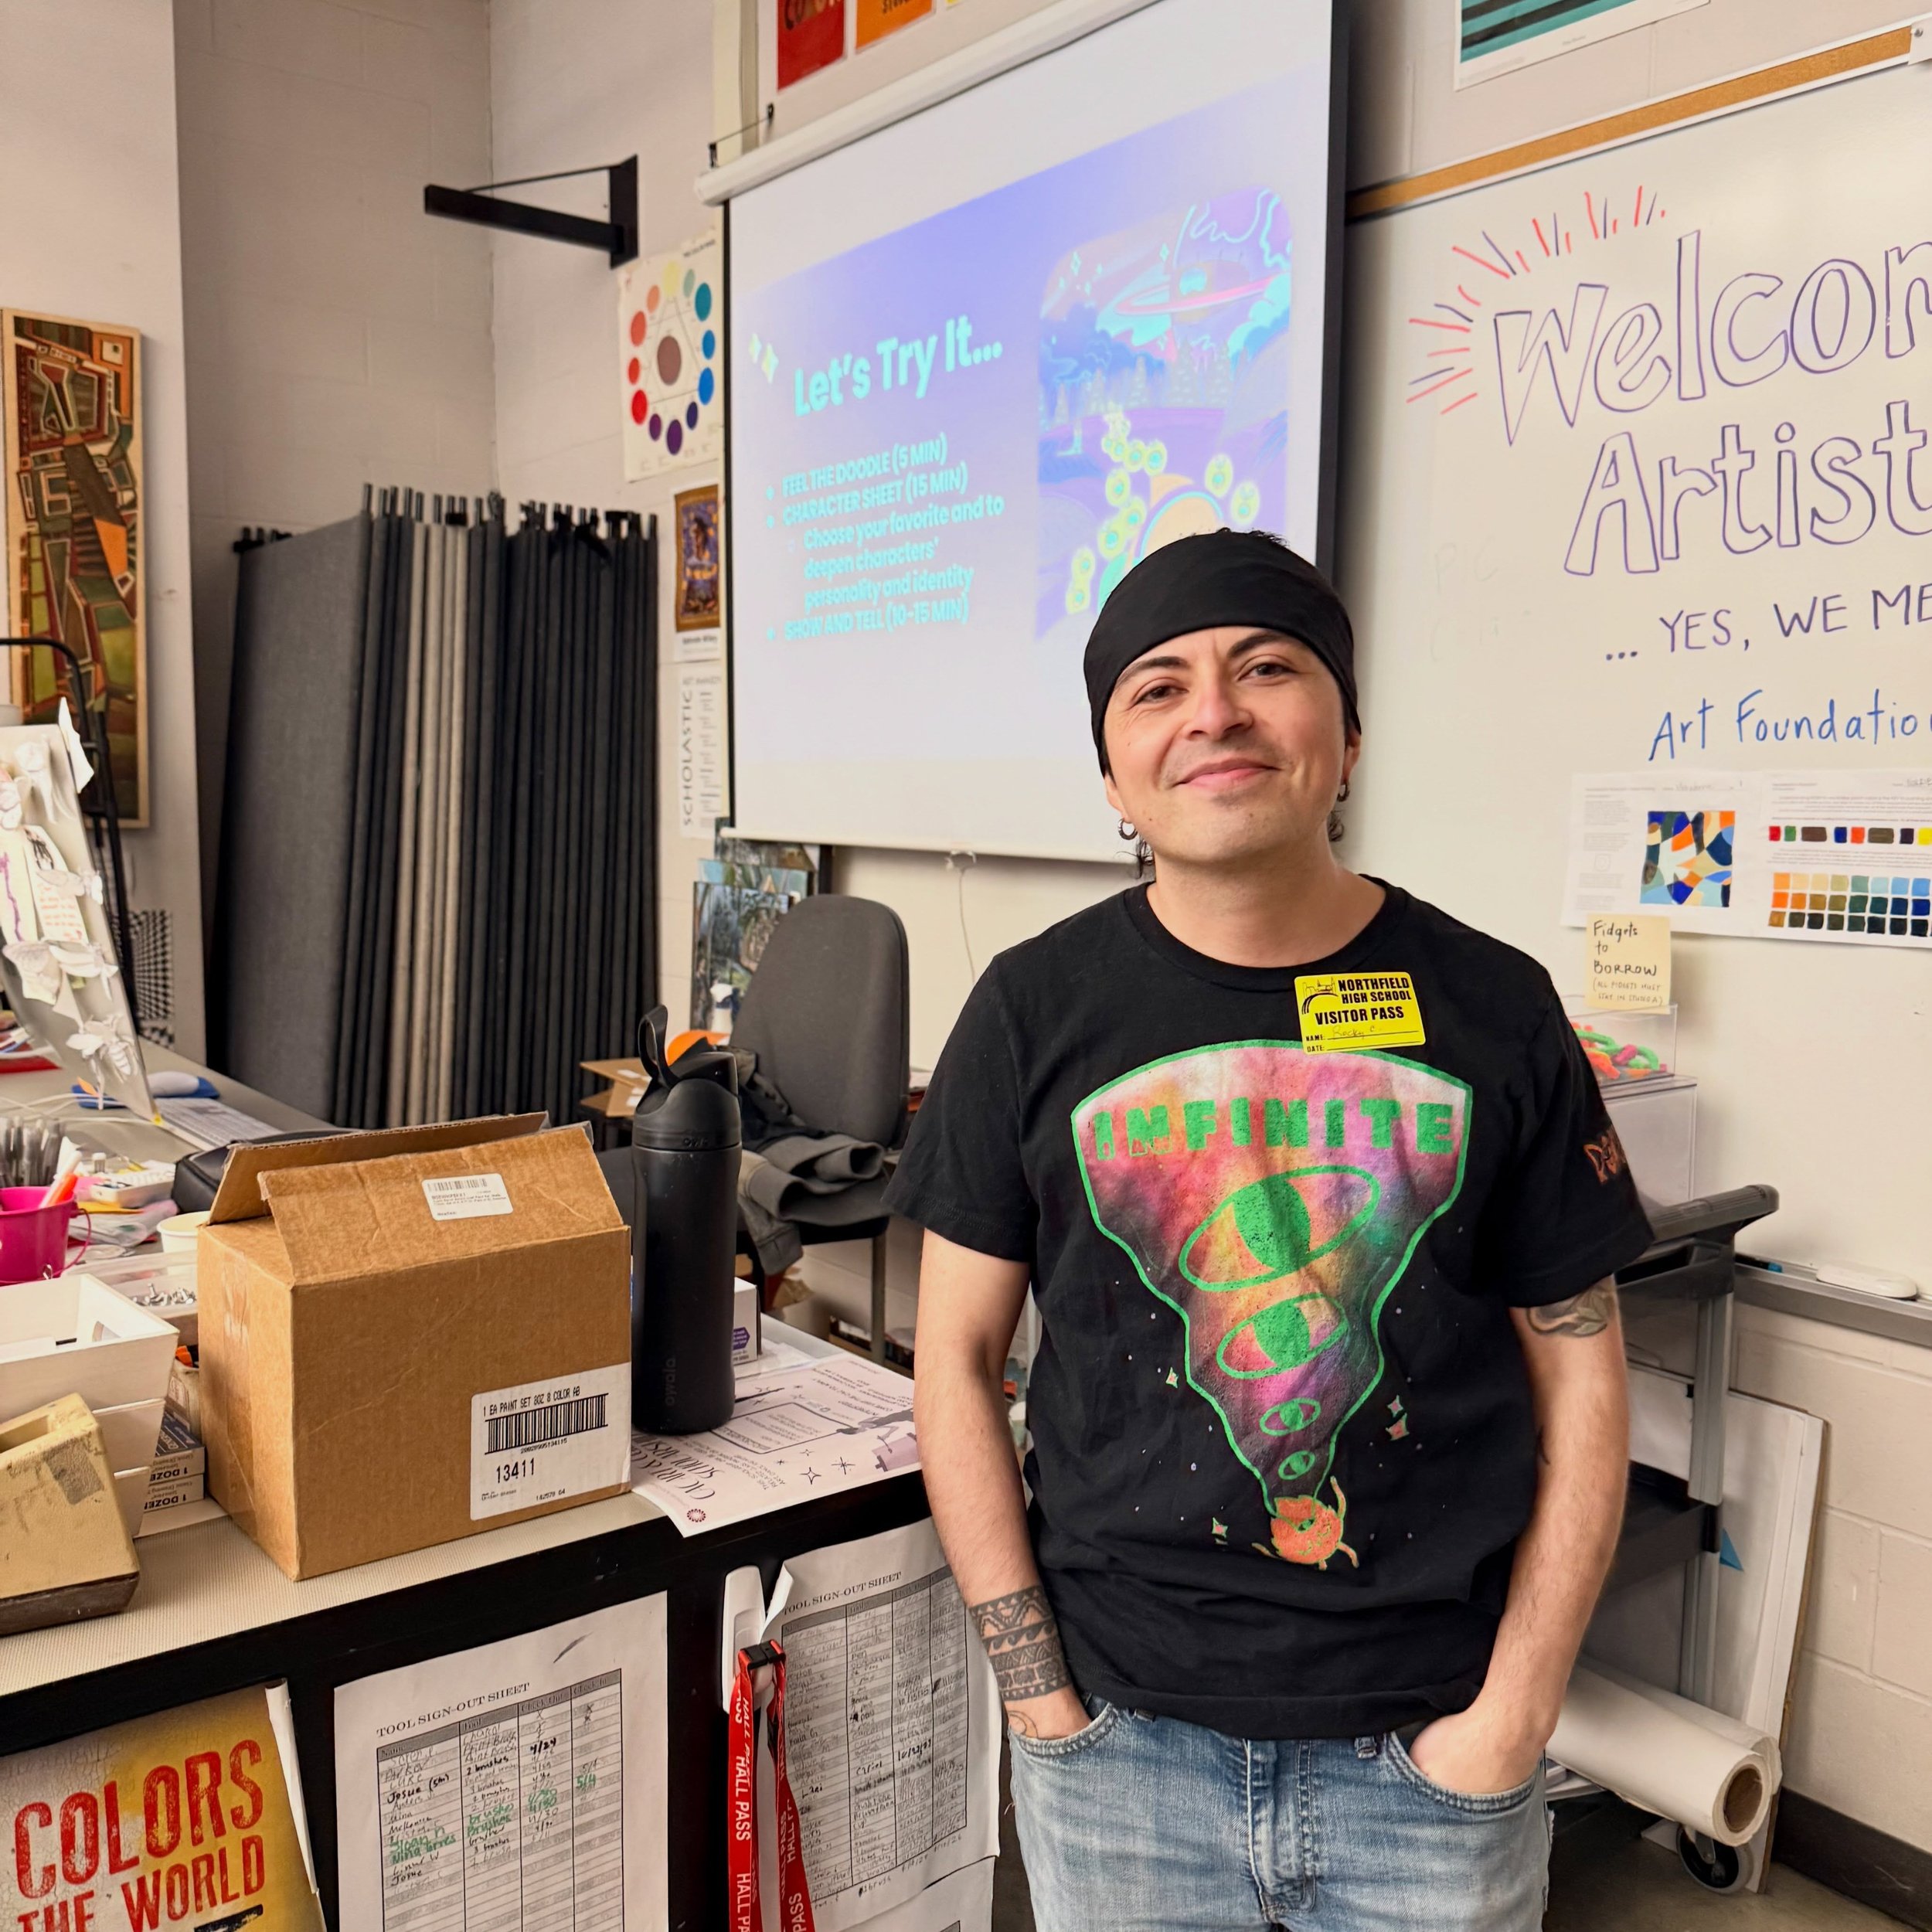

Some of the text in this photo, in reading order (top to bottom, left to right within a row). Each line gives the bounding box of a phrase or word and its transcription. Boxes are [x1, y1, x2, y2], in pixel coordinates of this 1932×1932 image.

[794, 352, 872, 417] Let's
[876, 334, 939, 400] Try
[781, 472, 809, 498] FEEL
[809, 465, 835, 491] THE
[835, 451, 890, 485] DOODLE
[910, 431, 948, 466] MIN)
[782, 460, 968, 526] CHARACTER SHEET (15 MIN)
[804, 493, 1005, 550] Choose your favorite and to
[804, 563, 975, 615] personality and identity
[784, 615, 823, 641] SHOW
[824, 612, 852, 636] AND
[855, 608, 883, 631] TELL
[930, 591, 970, 626] MIN)
[1659, 609, 1750, 653] YES,
[1773, 594, 1849, 638] WE
[1648, 688, 1932, 761] Art Foundatio
[1594, 920, 1638, 943] Fidgets
[1595, 940, 1608, 955] to
[1338, 978, 1410, 992] NORTHFIELD
[1594, 959, 1657, 977] BORROW
[1315, 1006, 1404, 1026] VISITOR PASS
[1342, 990, 1411, 1004] HIGH SCHOOL
[1332, 1026, 1366, 1039] Rocky
[483, 1406, 486, 1417] 1
[489, 1403, 498, 1416] EA
[499, 1399, 518, 1413] PAINT
[520, 1396, 532, 1408] SET
[547, 1392, 551, 1403] 8
[553, 1387, 571, 1402] COLOR
[662, 1358, 677, 1406] owala
[495, 1457, 535, 1485] 13411
[784, 1571, 902, 1616] TOOL SIGN-OUT SHEET
[376, 1682, 530, 1737] TOOL SIGN-OUT SHEET
[14, 1739, 264, 1900] COLORS
[735, 1755, 750, 1842] HALL PASS
[786, 1822, 796, 1864] HALL
[121, 1835, 266, 1932] WORLD
[736, 1872, 750, 1913] HALL
[789, 1893, 807, 1932] PASS
